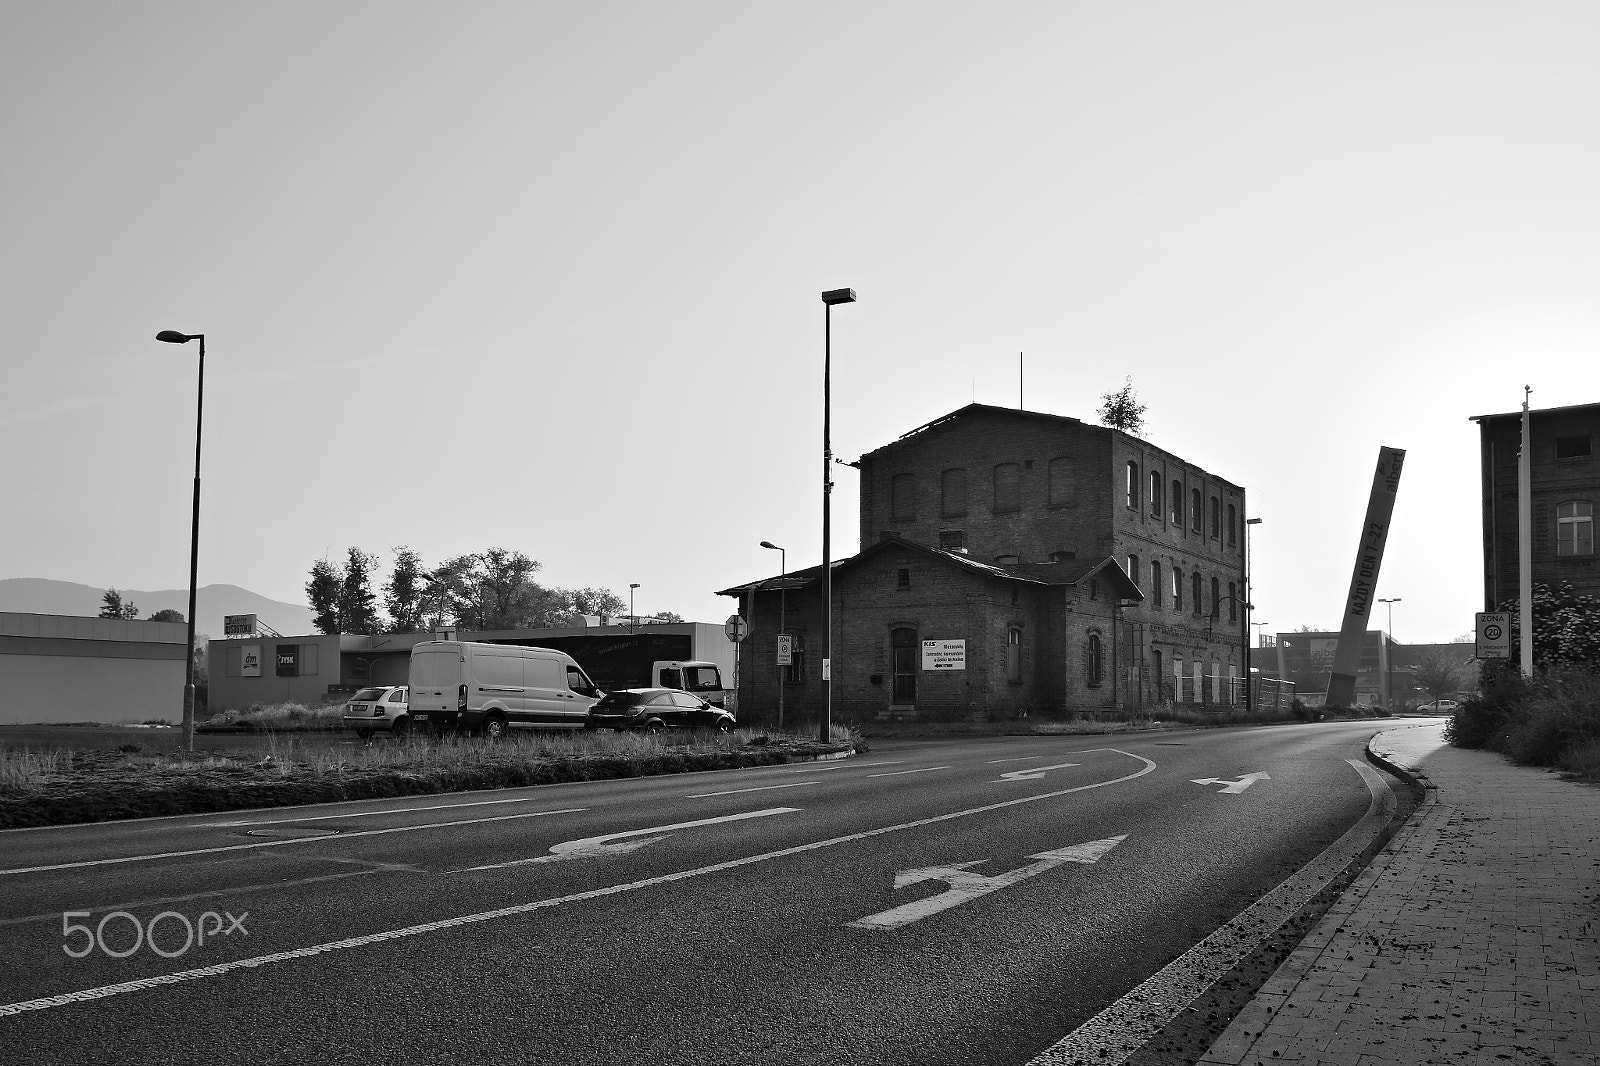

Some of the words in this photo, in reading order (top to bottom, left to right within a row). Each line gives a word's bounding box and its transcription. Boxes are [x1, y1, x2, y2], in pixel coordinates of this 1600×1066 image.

[1385, 451, 1404, 492] albert
[1360, 555, 1377, 578] DEN
[1351, 580, 1370, 616] KAŽDÝ
[1488, 628, 1499, 636] 20
[245, 653, 257, 664] dm
[280, 656, 294, 664] JYSK
